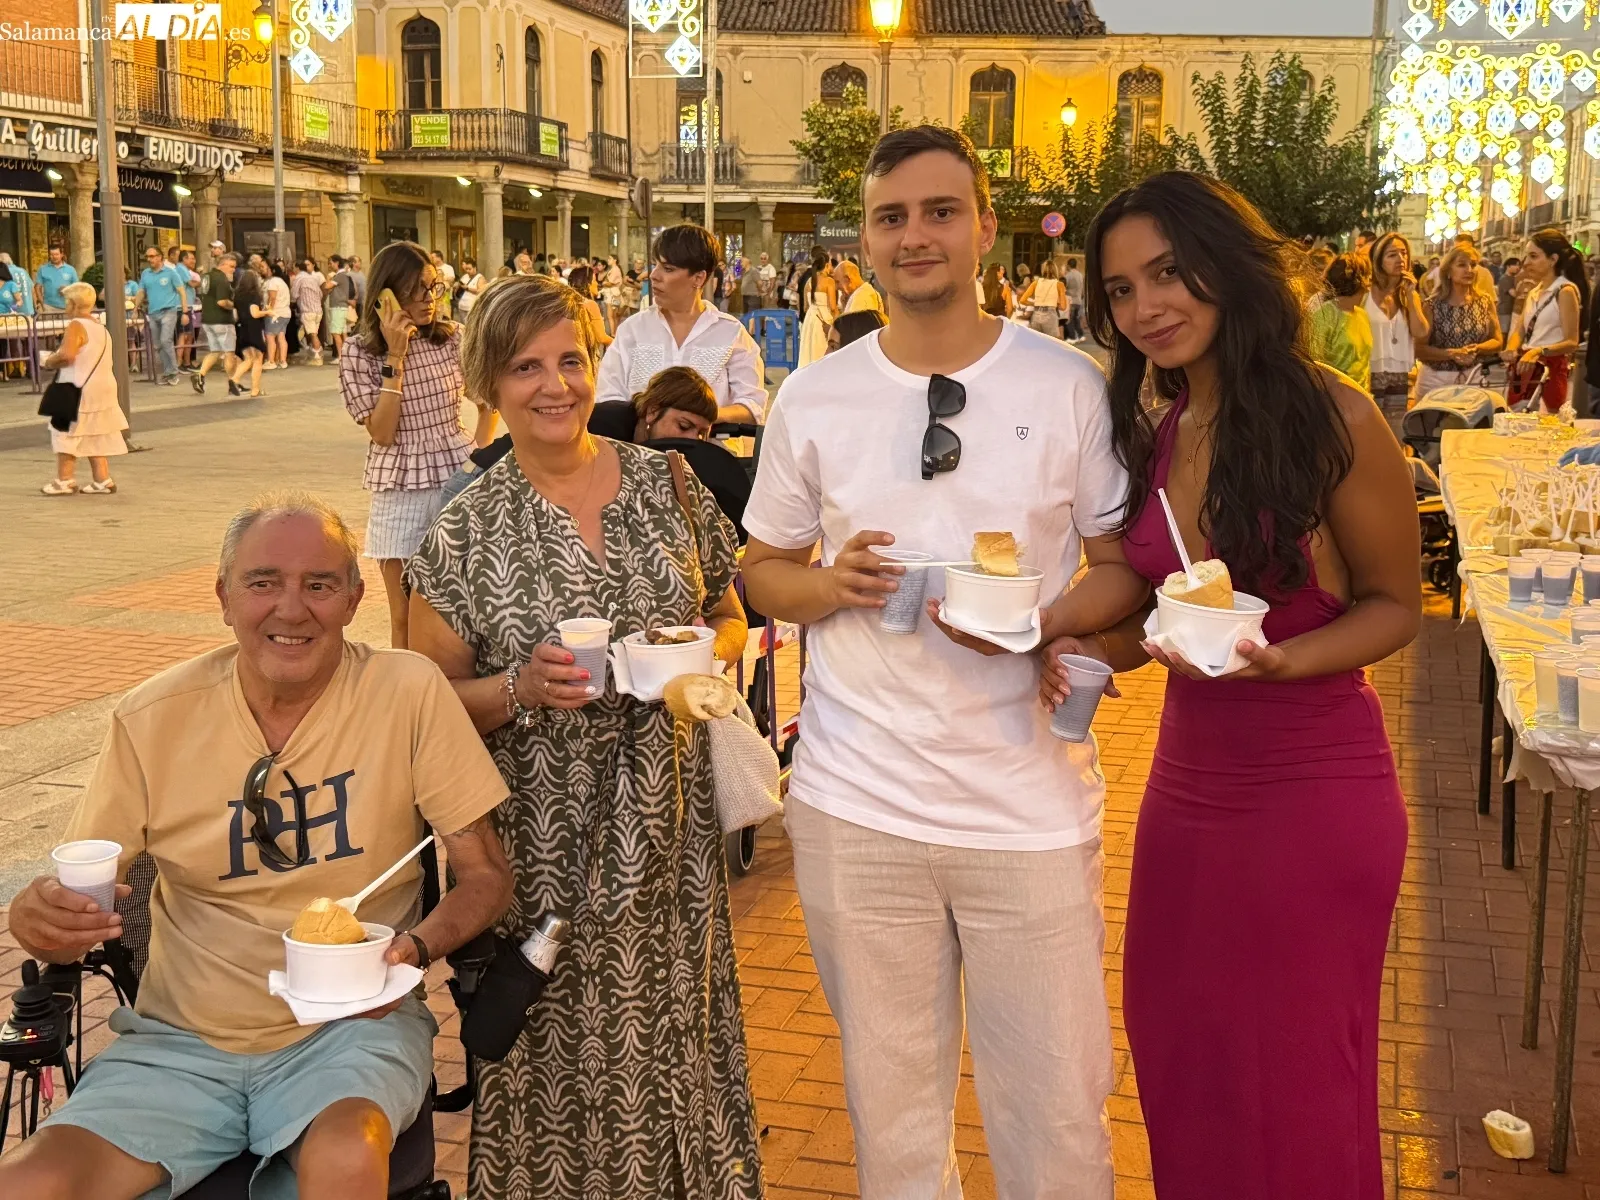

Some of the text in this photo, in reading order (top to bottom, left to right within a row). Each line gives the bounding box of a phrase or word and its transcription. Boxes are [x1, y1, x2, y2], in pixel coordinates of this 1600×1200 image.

[414, 116, 447, 124] VENDE
[31, 122, 129, 159] Guillero
[149, 137, 244, 173] EMBUTIDOS
[820, 226, 858, 237] Estrella
